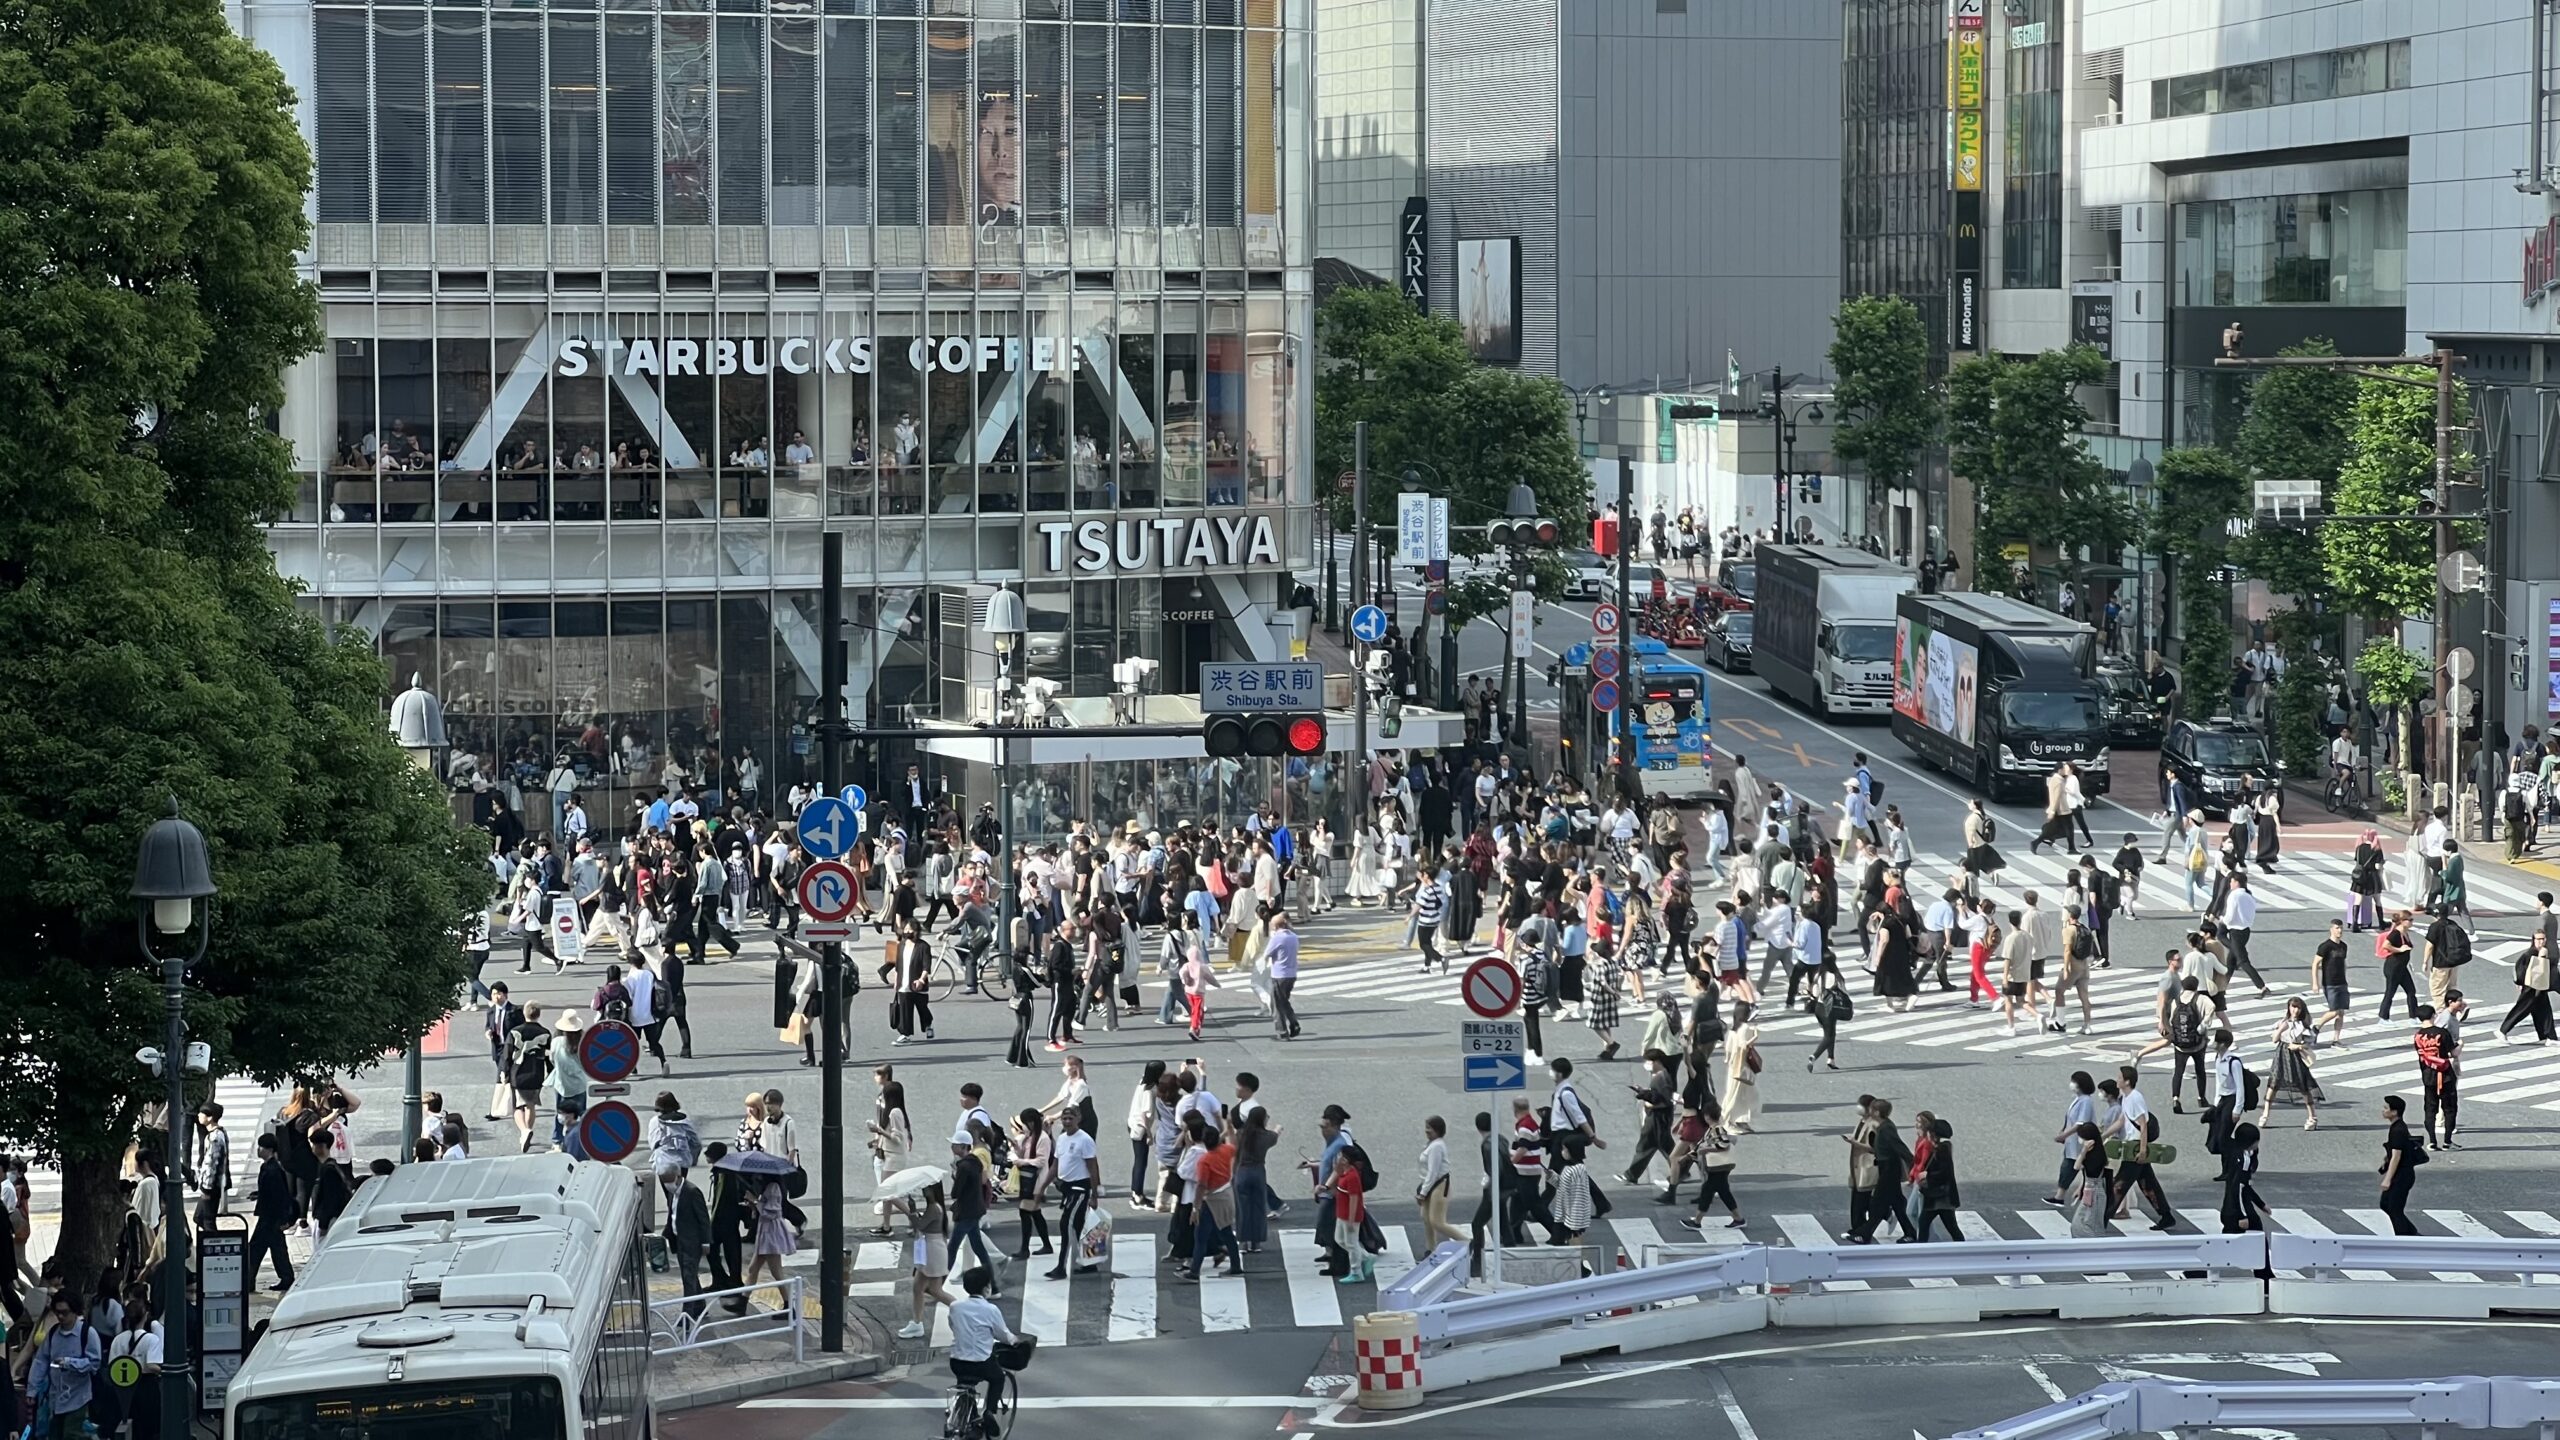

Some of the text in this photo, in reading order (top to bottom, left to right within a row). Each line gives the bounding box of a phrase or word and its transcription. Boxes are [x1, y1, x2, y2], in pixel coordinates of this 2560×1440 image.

[1963, 33, 1976, 42] 4F
[1405, 214, 1424, 297] ZARA
[1962, 277, 1972, 345] McDonald's
[558, 336, 1081, 377] STARBUCKS COFFEE
[1402, 509, 1410, 536] Shibuya
[1411, 500, 1424, 559] 渋谷駅前
[1433, 501, 1443, 557] スクランブル式
[1038, 515, 1280, 571] TSUTAYA
[1171, 610, 1214, 620] COFFEE
[1210, 669, 1314, 692] 渋谷駅前
[1226, 694, 1302, 708] Shibuya Sta.
[2045, 745, 2072, 754] group
[2074, 742, 2084, 752] BJ
[1464, 1023, 1520, 1035] 路線バスを除く
[1473, 1038, 1512, 1051] 6-22
